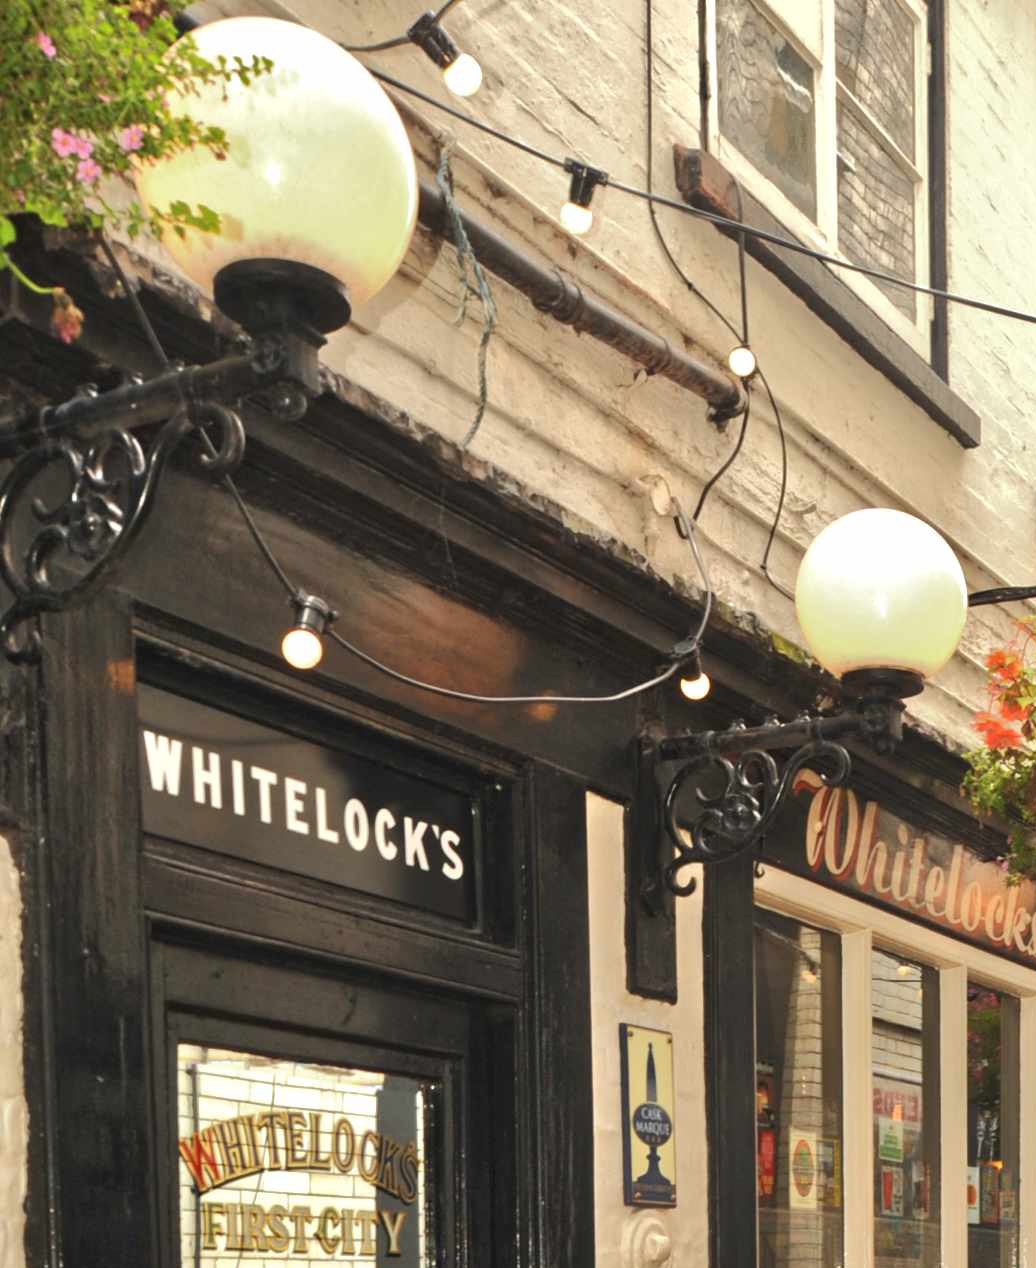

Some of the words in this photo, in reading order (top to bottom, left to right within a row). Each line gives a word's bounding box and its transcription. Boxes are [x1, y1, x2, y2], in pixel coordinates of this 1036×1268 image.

[143, 730, 465, 881] WHITELOCK'S
[636, 1120, 670, 1137] MARQUE
[640, 1106, 661, 1121] CASK
[202, 1202, 310, 1254] FIRST
[314, 1206, 408, 1256] CITY
